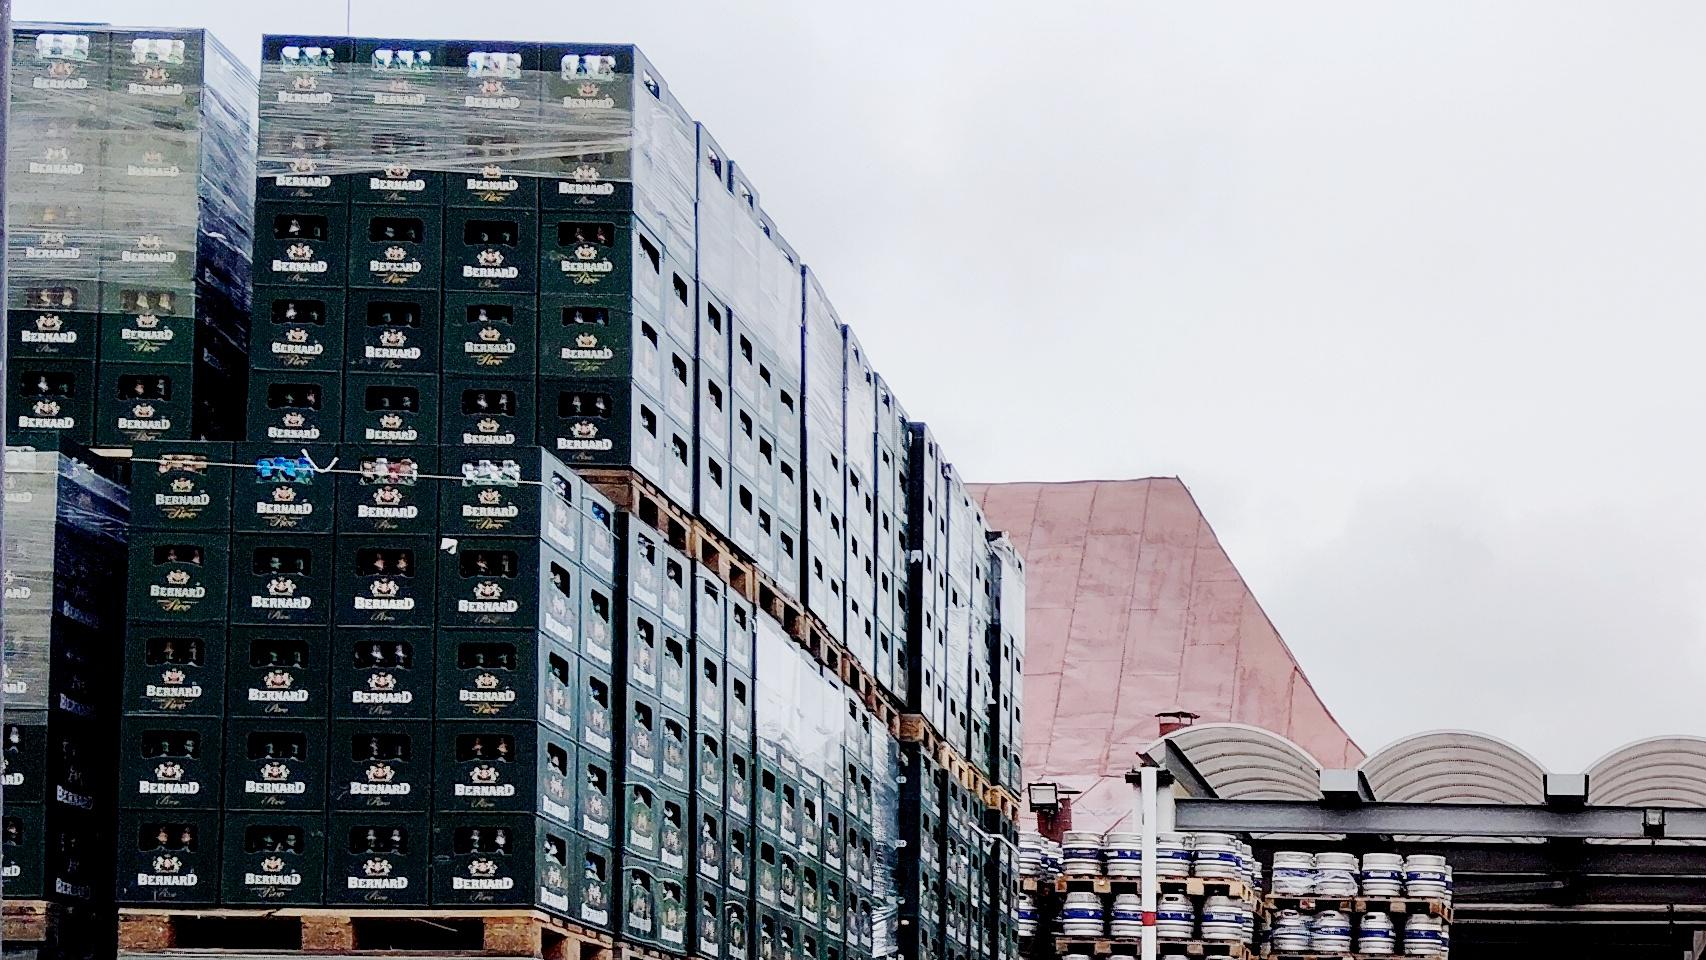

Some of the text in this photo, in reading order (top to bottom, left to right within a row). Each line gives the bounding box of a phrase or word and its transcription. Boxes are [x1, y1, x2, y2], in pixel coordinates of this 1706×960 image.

[275, 174, 331, 188] BERNARD
[370, 178, 424, 191] BERNARD
[467, 178, 518, 191] BERNARD
[559, 181, 614, 194] BERNARD
[272, 259, 327, 273] BERNARD
[370, 259, 421, 273] BERNARD
[463, 265, 518, 279] BERNARD
[561, 259, 612, 272] BERNARD
[22, 329, 77, 343] BERNARD
[121, 327, 173, 341] BERNARD
[272, 342, 323, 355] BERNARD
[365, 346, 420, 359] BERNARD
[465, 341, 515, 354] BERNARD
[561, 347, 612, 360] BERNARD
[19, 416, 74, 429] BERNARD
[118, 418, 170, 430] BERNARD
[267, 427, 319, 440] BERNARD
[366, 427, 417, 440] BERNARD
[463, 431, 515, 444] BERNARD
[557, 438, 612, 452] BERNARD
[155, 493, 209, 506] BERNARD
[257, 502, 312, 516] BERNARD
[358, 505, 417, 519] BERNARD
[463, 504, 518, 518] BERNARD
[150, 586, 205, 599] BERNARD
[252, 595, 311, 609] BERNARD
[354, 597, 413, 611] BERNARD
[458, 600, 517, 614] BERNARD
[147, 686, 202, 699] BERNARD
[248, 689, 307, 703] BERNARD
[353, 690, 411, 704] BERNARD
[459, 689, 515, 702] BERNARD
[139, 780, 199, 795] BERNARD
[246, 780, 305, 795] BERNARD
[350, 782, 409, 796] BERNARD
[454, 783, 514, 797] BERNARD
[137, 873, 197, 887] BERNARD
[245, 873, 301, 886] BERNARD
[348, 876, 407, 890] BERNARD
[453, 876, 512, 890] BERNARD
